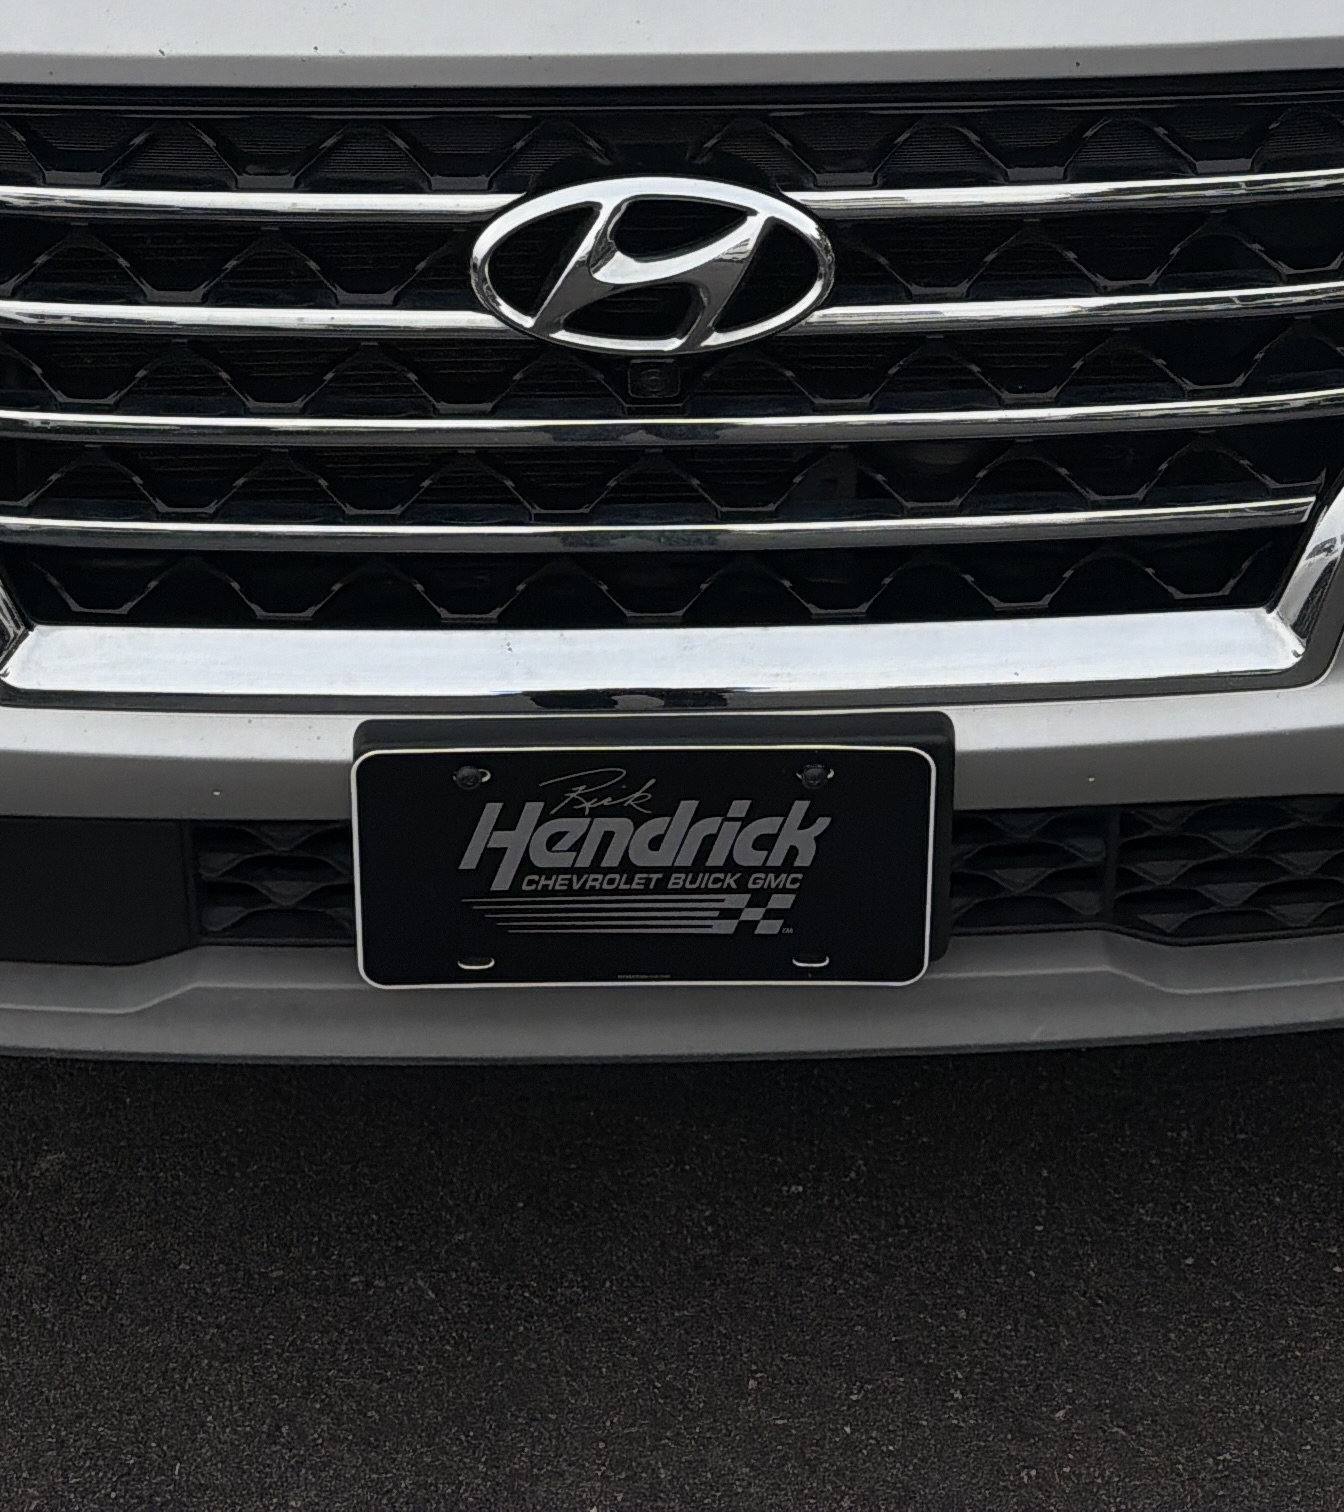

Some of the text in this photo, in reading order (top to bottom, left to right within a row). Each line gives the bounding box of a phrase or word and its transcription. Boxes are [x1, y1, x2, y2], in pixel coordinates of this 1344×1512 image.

[457, 799, 832, 891] Hendrick
[521, 872, 804, 891] CHEVROLET BUICK GMC
